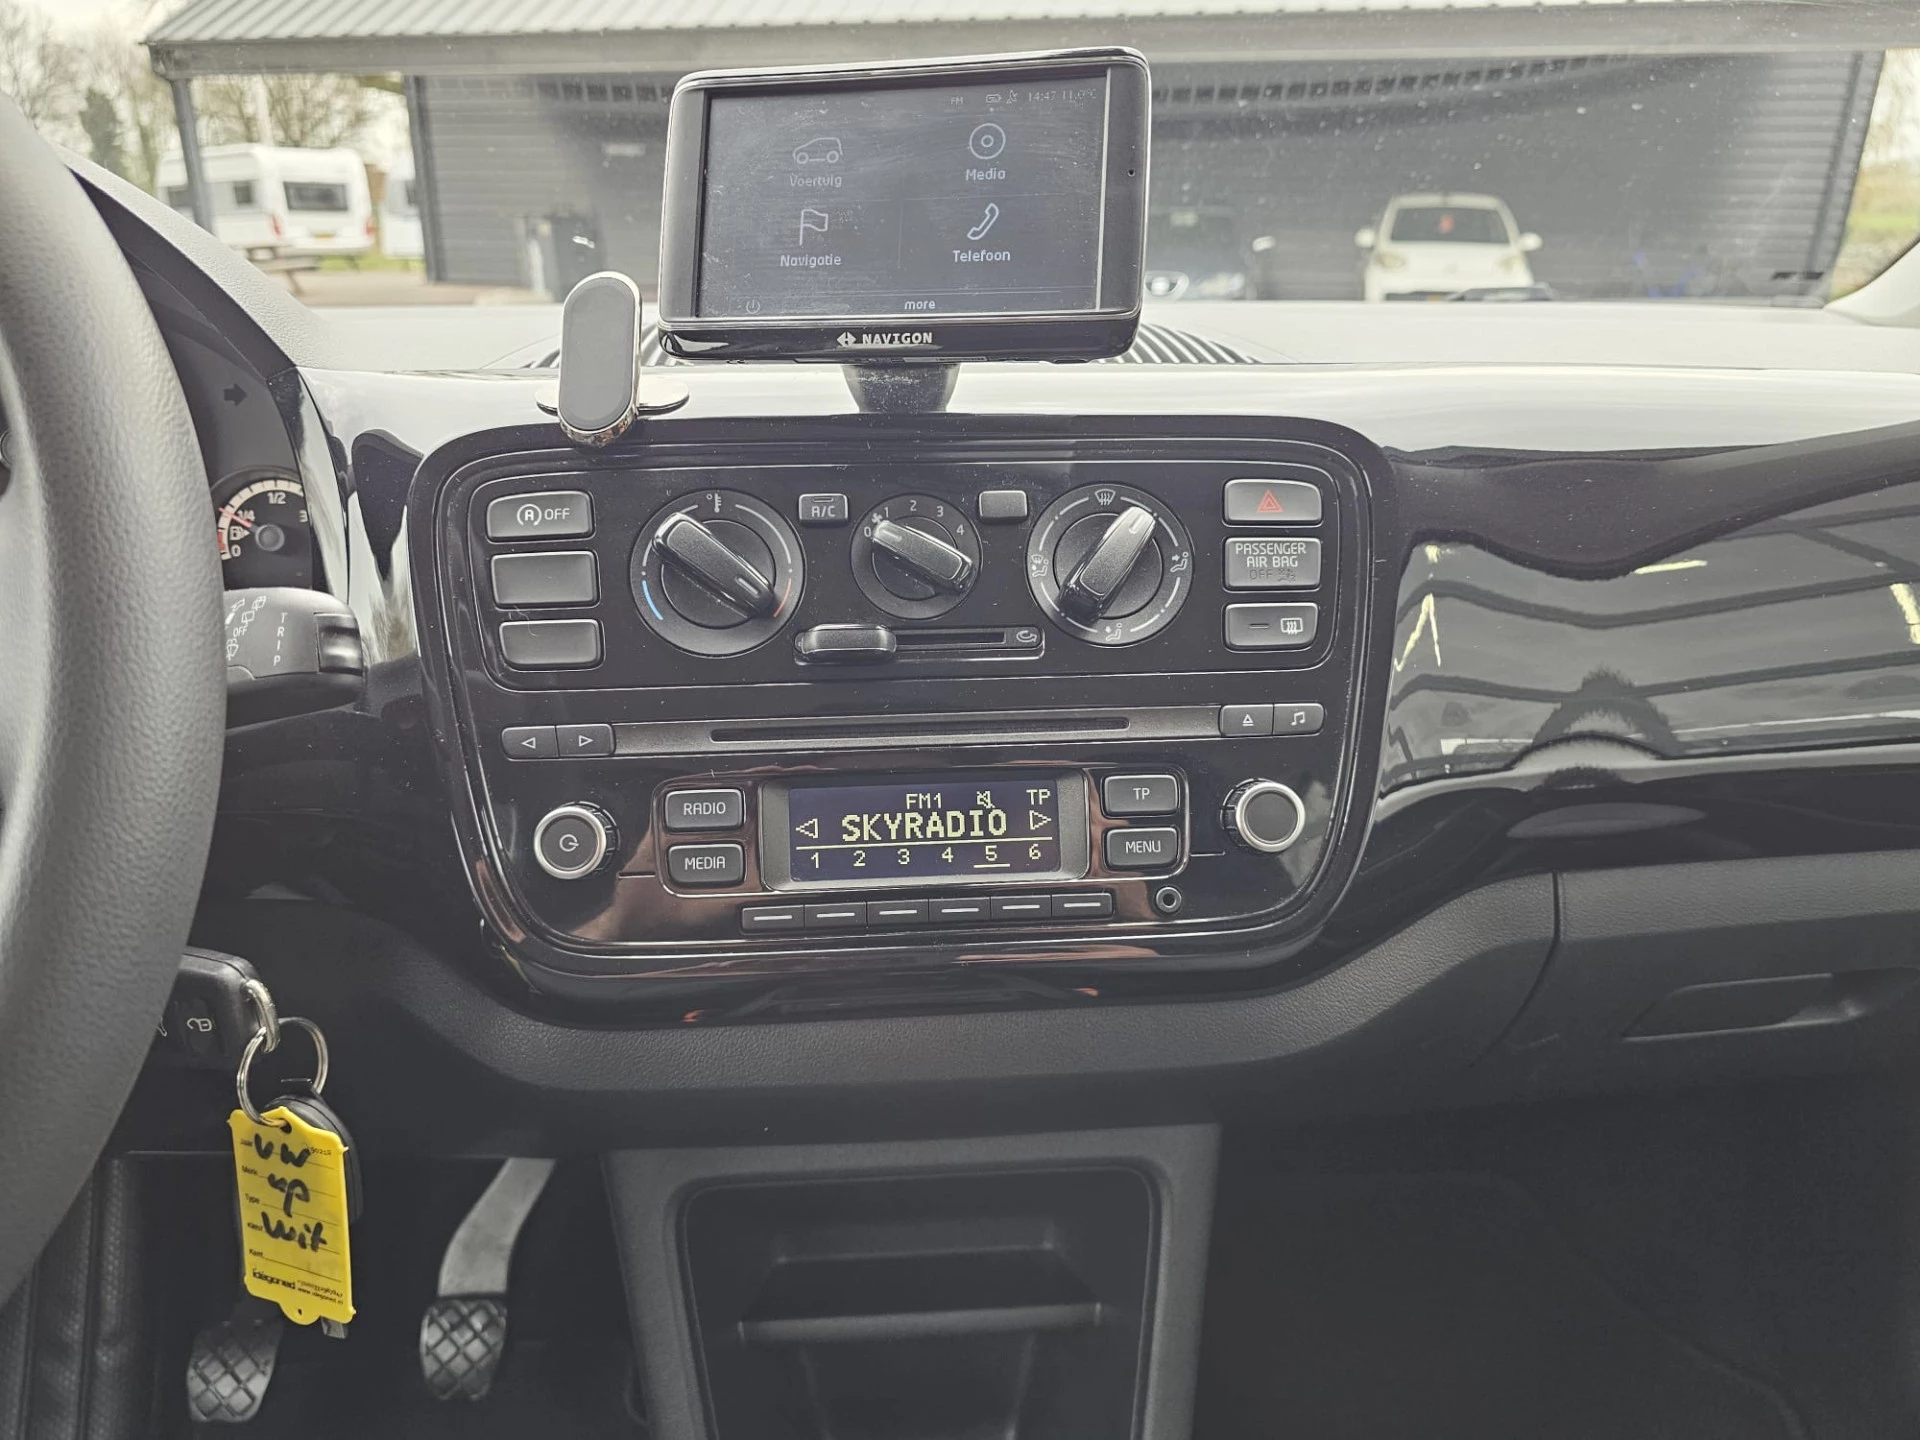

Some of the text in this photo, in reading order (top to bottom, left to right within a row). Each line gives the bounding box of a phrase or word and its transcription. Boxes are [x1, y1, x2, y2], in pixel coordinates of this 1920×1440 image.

[789, 174, 842, 188] Voertuig
[965, 168, 1006, 181] Media
[780, 254, 842, 268] Navigatie
[953, 249, 1011, 263] Telefoon
[904, 300, 936, 311] more
[862, 332, 933, 346] NAVIGON
[267, 491, 286, 505] 1/2
[811, 505, 836, 518] A/C
[884, 506, 889, 518] 1
[910, 500, 917, 511] 2
[936, 506, 944, 517] 3
[544, 507, 571, 521] OFF
[863, 526, 872, 537] 0
[956, 524, 965, 535] 4
[231, 544, 242, 557] 0
[1235, 542, 1308, 556] PASSENGER
[1246, 556, 1299, 568] AIR BAG
[1249, 568, 1273, 581] OFF
[233, 625, 248, 638] OFF
[906, 789, 1051, 810] FM1 TP
[1133, 787, 1150, 801] TP
[683, 802, 726, 816] RADIO
[841, 809, 1007, 842] SKYRADIO
[1125, 840, 1161, 854] MENU
[811, 843, 1042, 869] 1 2 3 4 5 6
[684, 857, 726, 871] MEDIA
